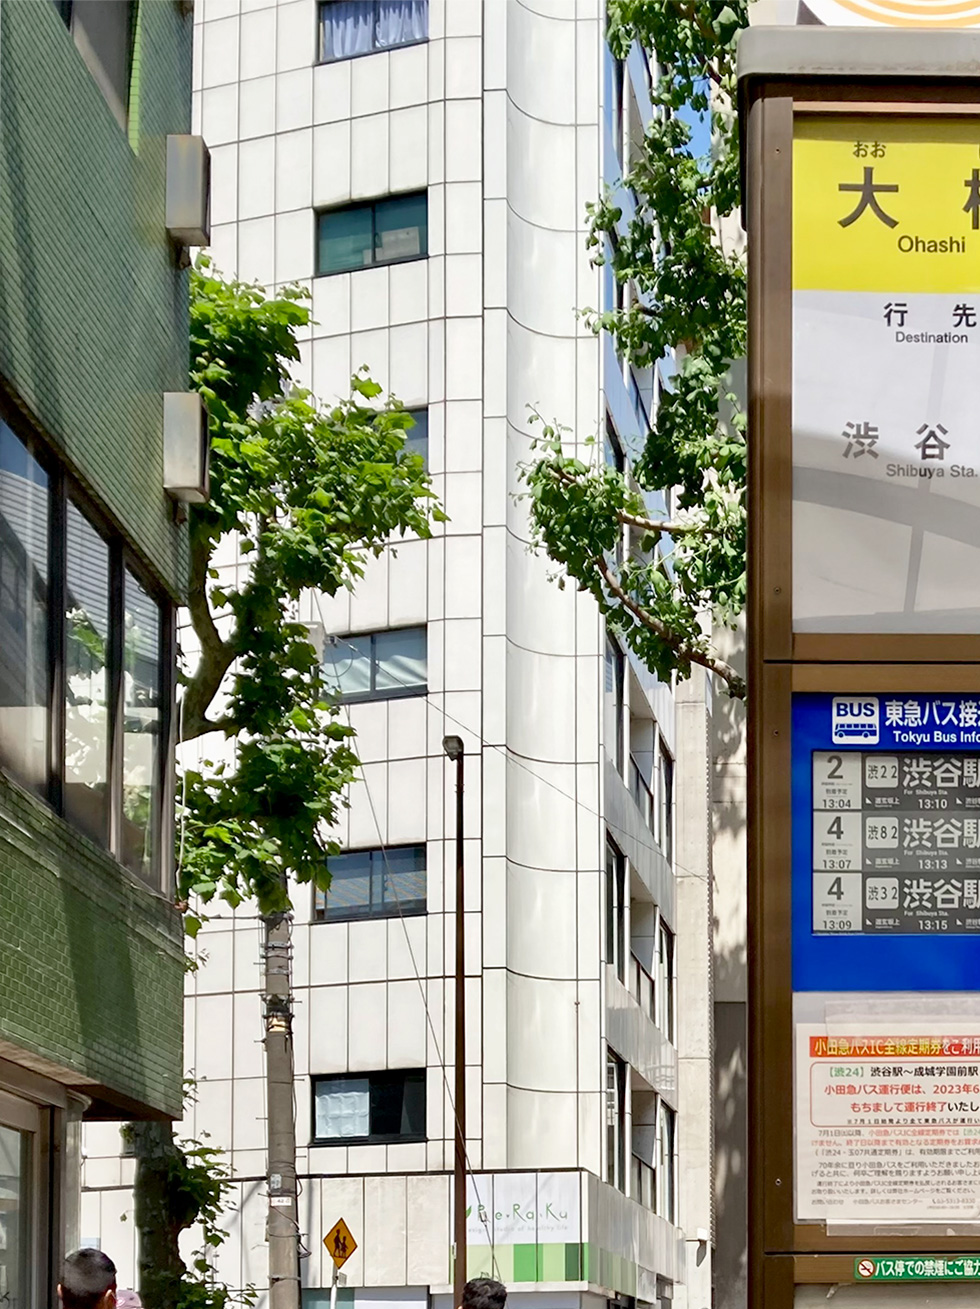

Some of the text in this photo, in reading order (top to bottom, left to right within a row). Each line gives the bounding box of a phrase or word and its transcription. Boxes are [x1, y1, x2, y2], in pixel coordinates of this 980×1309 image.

[853, 141, 886, 158] おお
[897, 235, 966, 253] Ohashi
[895, 331, 968, 343] Destination
[886, 464, 978, 479] Shibuya Sta.
[836, 702, 875, 717] BUS
[893, 731, 930, 745] Tokyu
[934, 731, 957, 743] Bus
[827, 755, 844, 779] 2
[822, 799, 851, 808] 13:04
[918, 799, 948, 809] 13:10
[827, 816, 844, 840] 4
[822, 860, 851, 870] 13:07
[918, 860, 948, 870] 13:13
[827, 876, 844, 900] 4
[822, 920, 851, 930] 13:09
[918, 920, 948, 930] 13:15
